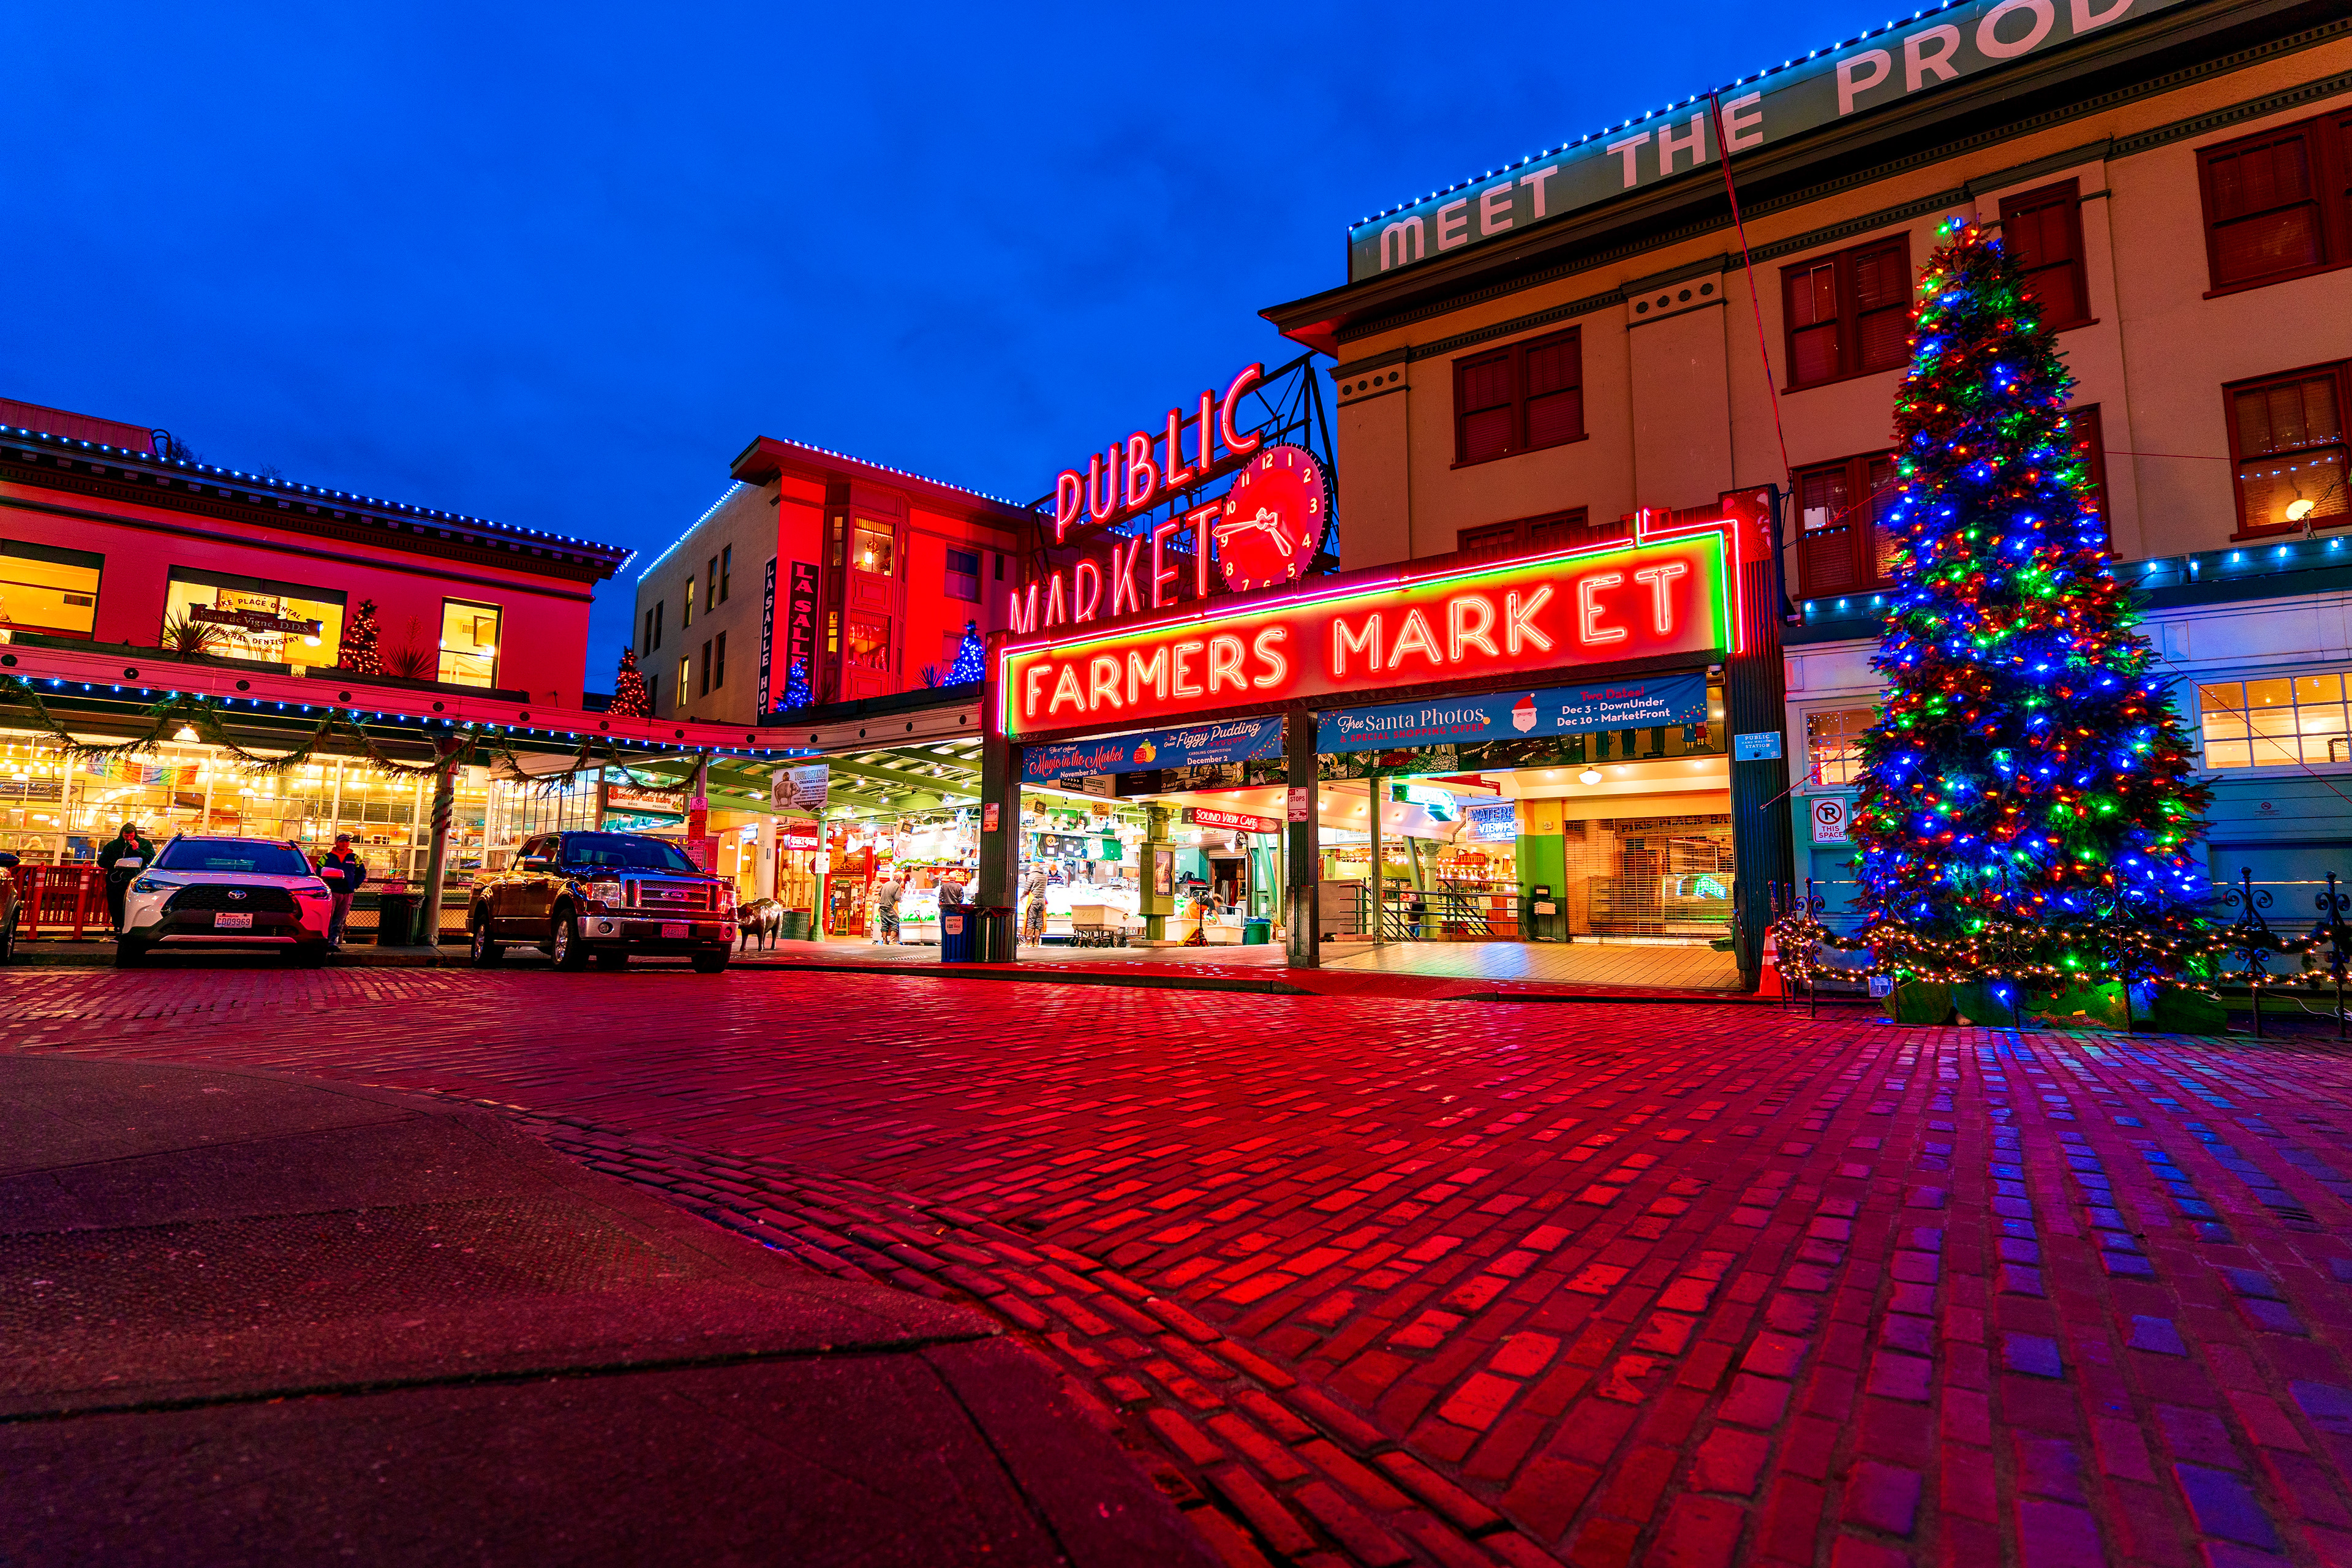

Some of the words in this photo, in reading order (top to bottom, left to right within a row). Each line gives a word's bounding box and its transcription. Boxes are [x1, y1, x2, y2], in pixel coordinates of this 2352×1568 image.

[1380, 164, 1558, 272] MEET
[1605, 91, 1763, 189] THE
[1056, 362, 1265, 545] PUBLIC
[1262, 453, 1275, 470] 12
[1288, 452, 1294, 467] 1
[1241, 471, 1250, 488] 11
[1303, 467, 1313, 483] 2
[1226, 500, 1237, 516] 10
[1309, 497, 1318, 514] 3
[1221, 535, 1229, 548] 9
[1302, 532, 1312, 548] 4
[1009, 498, 1223, 634] MARKET
[1226, 562, 1234, 577] 8
[1287, 562, 1297, 578] 5
[766, 564, 775, 592] LA
[794, 564, 813, 594] LA
[1242, 579, 1250, 591] 7
[238, 598, 266, 607] PLACE
[270, 602, 301, 620] DENTAL
[200, 610, 225, 621] Kent
[229, 615, 242, 624] de
[244, 616, 276, 628] Vigné,
[279, 621, 311, 633] D.D.S.
[252, 635, 300, 645] DENTISTRY
[761, 595, 773, 668] SALLE
[1026, 629, 1289, 716] FARMERS
[1333, 563, 1688, 676] MARKET
[1580, 691, 1604, 701] Two
[1605, 686, 1645, 699] Dates!
[1562, 705, 1583, 715] Dec
[1584, 705, 1591, 714] 3
[1599, 697, 1665, 712] DownUnder
[1337, 715, 1365, 734] Free
[1365, 714, 1415, 732] Santa
[1420, 707, 1485, 727] Photos
[1557, 717, 1579, 727] Dec
[1600, 707, 1671, 723] MarketFront
[1176, 731, 1210, 749] Figgy
[1210, 722, 1262, 742] Pudding
[1350, 733, 1389, 742] SPECIAL
[1393, 726, 1447, 739] SHOPPING
[1450, 723, 1485, 734] OFFER
[1029, 753, 1061, 777] Magic
[1061, 754, 1071, 767] in
[1071, 750, 1085, 766] the
[1085, 745, 1125, 771] Market
[1186, 755, 1223, 766] December
[794, 771, 807, 781] YOUR
[807, 768, 827, 779] CHANGE
[1060, 769, 1089, 778] November
[1196, 809, 1221, 823] SOUND
[1222, 812, 1239, 824] VIEW
[1240, 815, 1257, 826] CAFE
[1621, 820, 1653, 833] PIKE
[1659, 815, 1703, 827] PLACE
